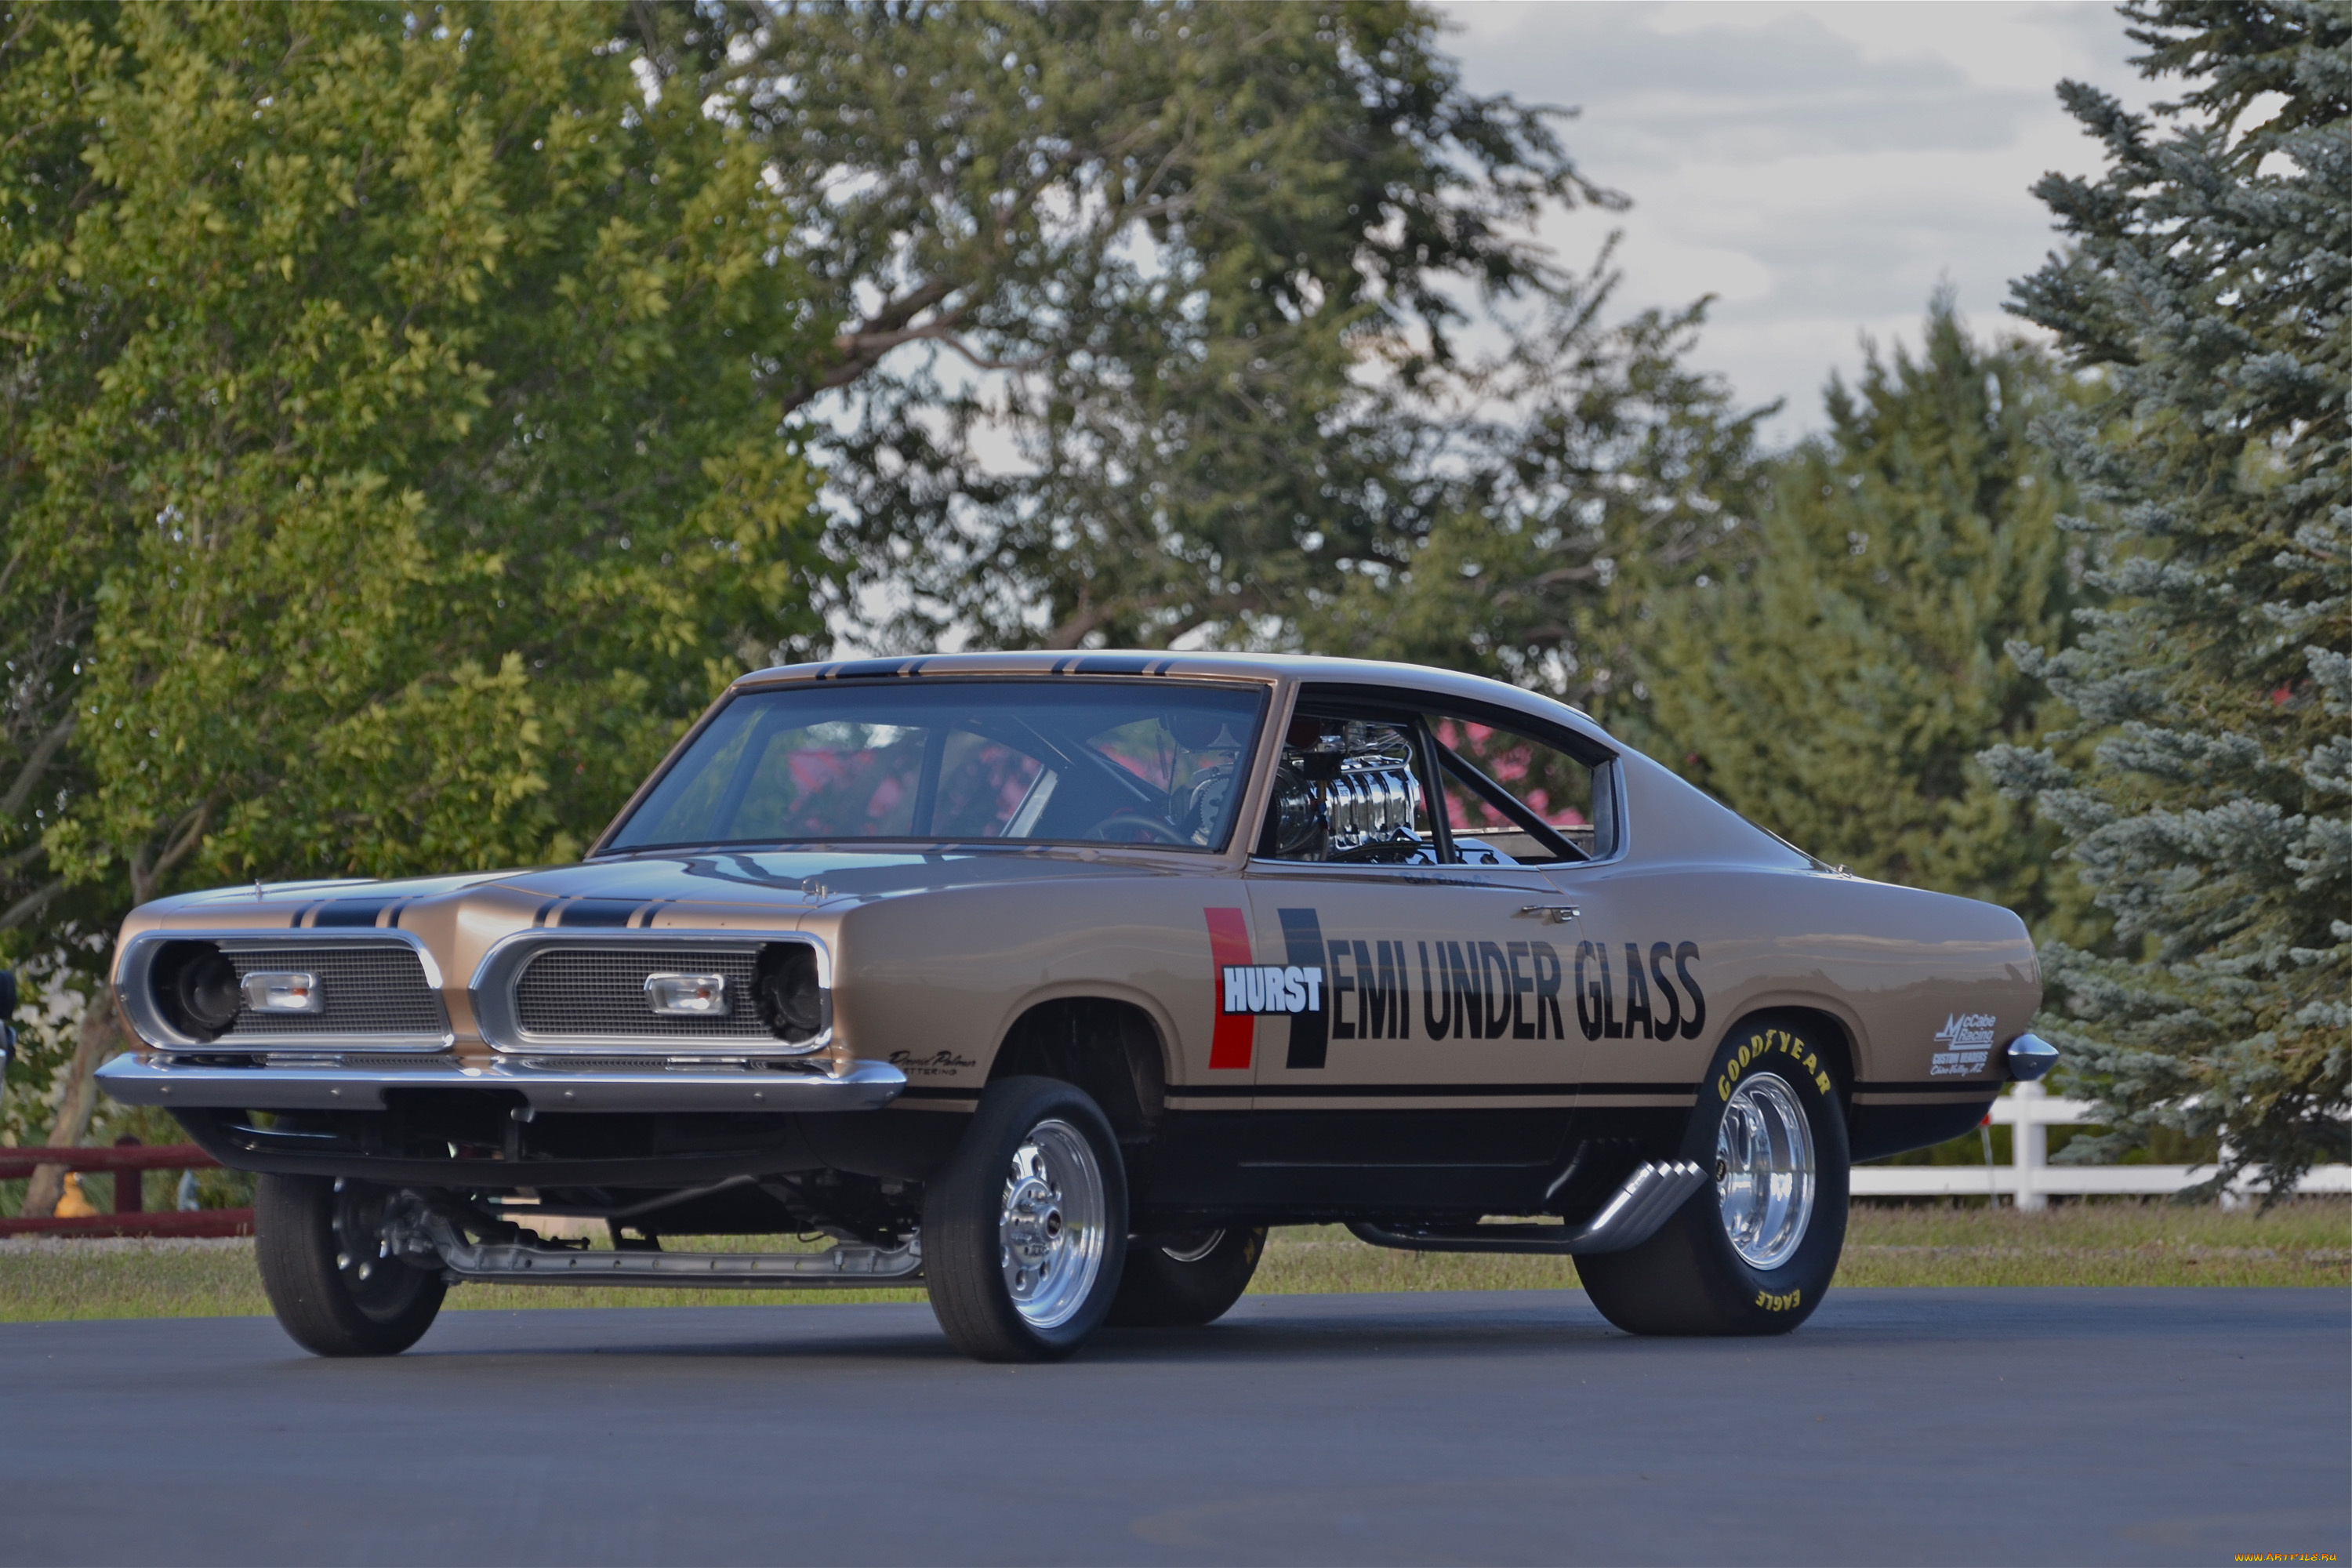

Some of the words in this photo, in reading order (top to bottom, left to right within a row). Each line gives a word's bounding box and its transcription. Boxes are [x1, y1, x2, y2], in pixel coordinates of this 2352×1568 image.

[1223, 965, 1323, 1013] HURST
[1418, 940, 1566, 1040] UNDER
[1575, 940, 1707, 1042] GLASS
[1935, 1013, 1996, 1043] McCabe
[1958, 1028, 1994, 1044] Racing
[889, 1050, 933, 1066] David
[1718, 1029, 1831, 1102] GOODYEAR
[1933, 1053, 1960, 1065] CUSTOM
[902, 1067, 957, 1076] ETTERING
[1755, 1289, 1801, 1312] EAGLE
